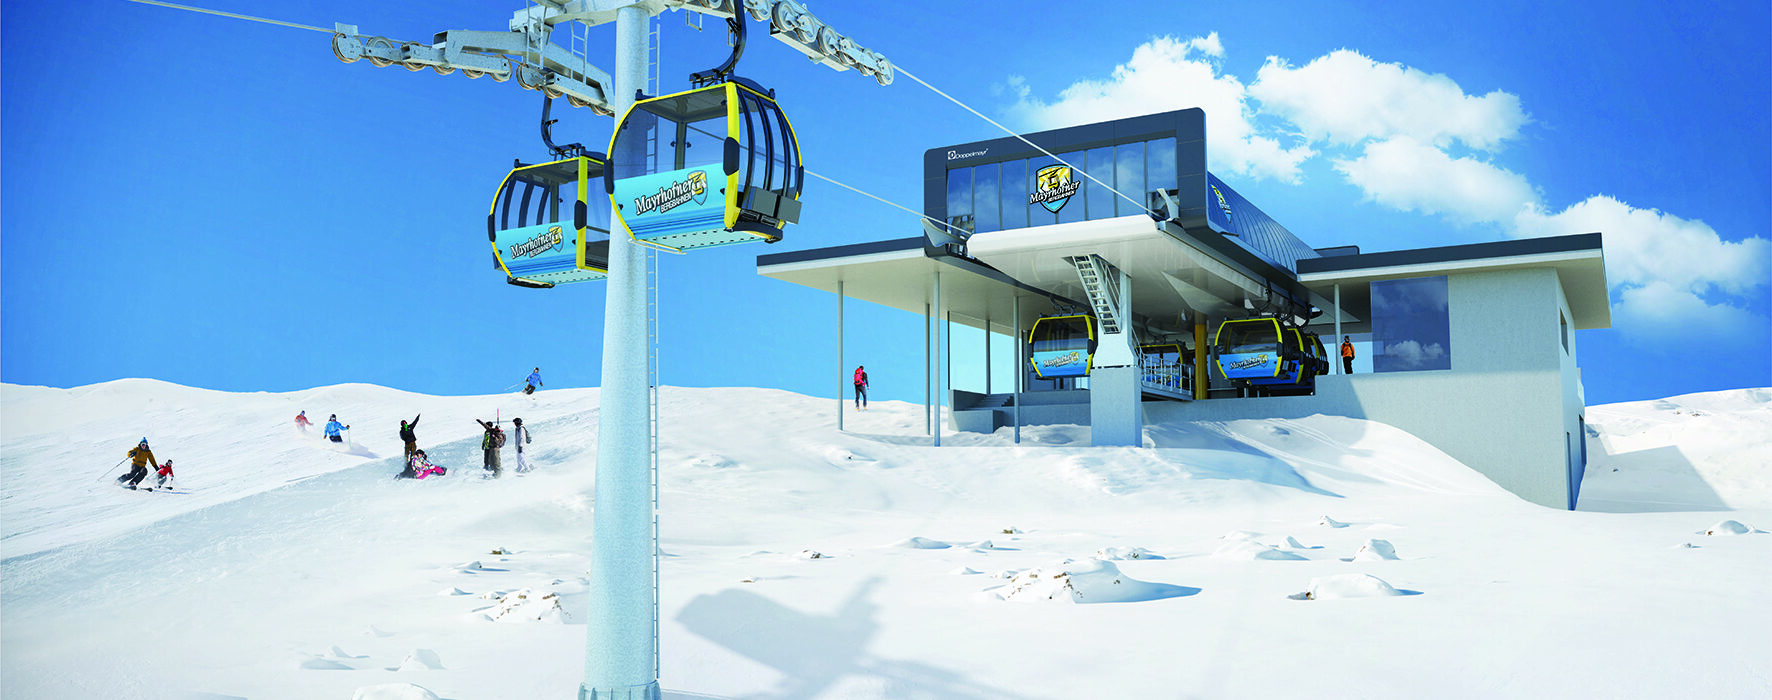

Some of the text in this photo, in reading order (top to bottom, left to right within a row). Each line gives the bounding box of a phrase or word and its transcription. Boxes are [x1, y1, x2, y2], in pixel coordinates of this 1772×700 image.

[634, 179, 694, 216] Mayrhofner
[660, 192, 692, 213] BERGBAHNEN
[1029, 180, 1081, 205] Mayrhofner
[510, 232, 553, 259] Mayrhofner
